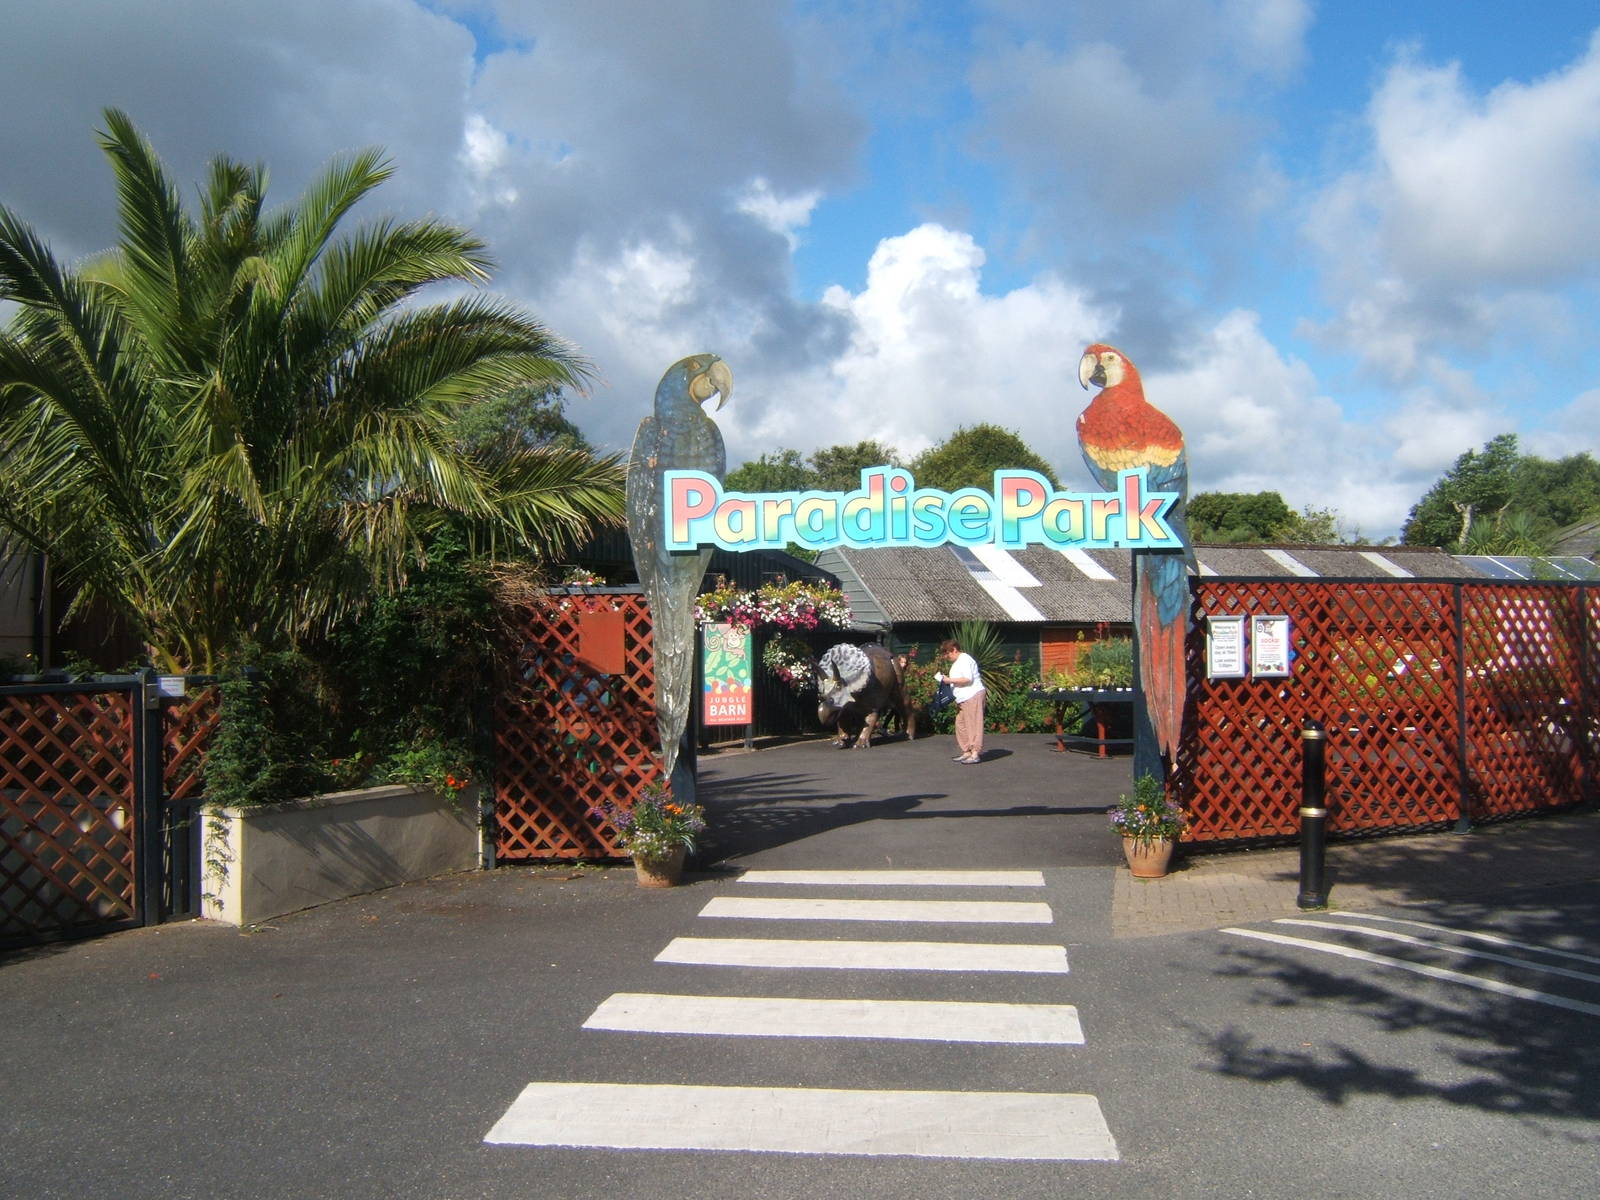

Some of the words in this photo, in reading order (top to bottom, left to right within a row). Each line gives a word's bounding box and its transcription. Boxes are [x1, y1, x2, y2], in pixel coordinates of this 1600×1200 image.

[670, 472, 992, 543] Paradise
[1000, 474, 1170, 544] Park
[709, 696, 746, 704] JUNGLE
[709, 704, 746, 716] BARN
